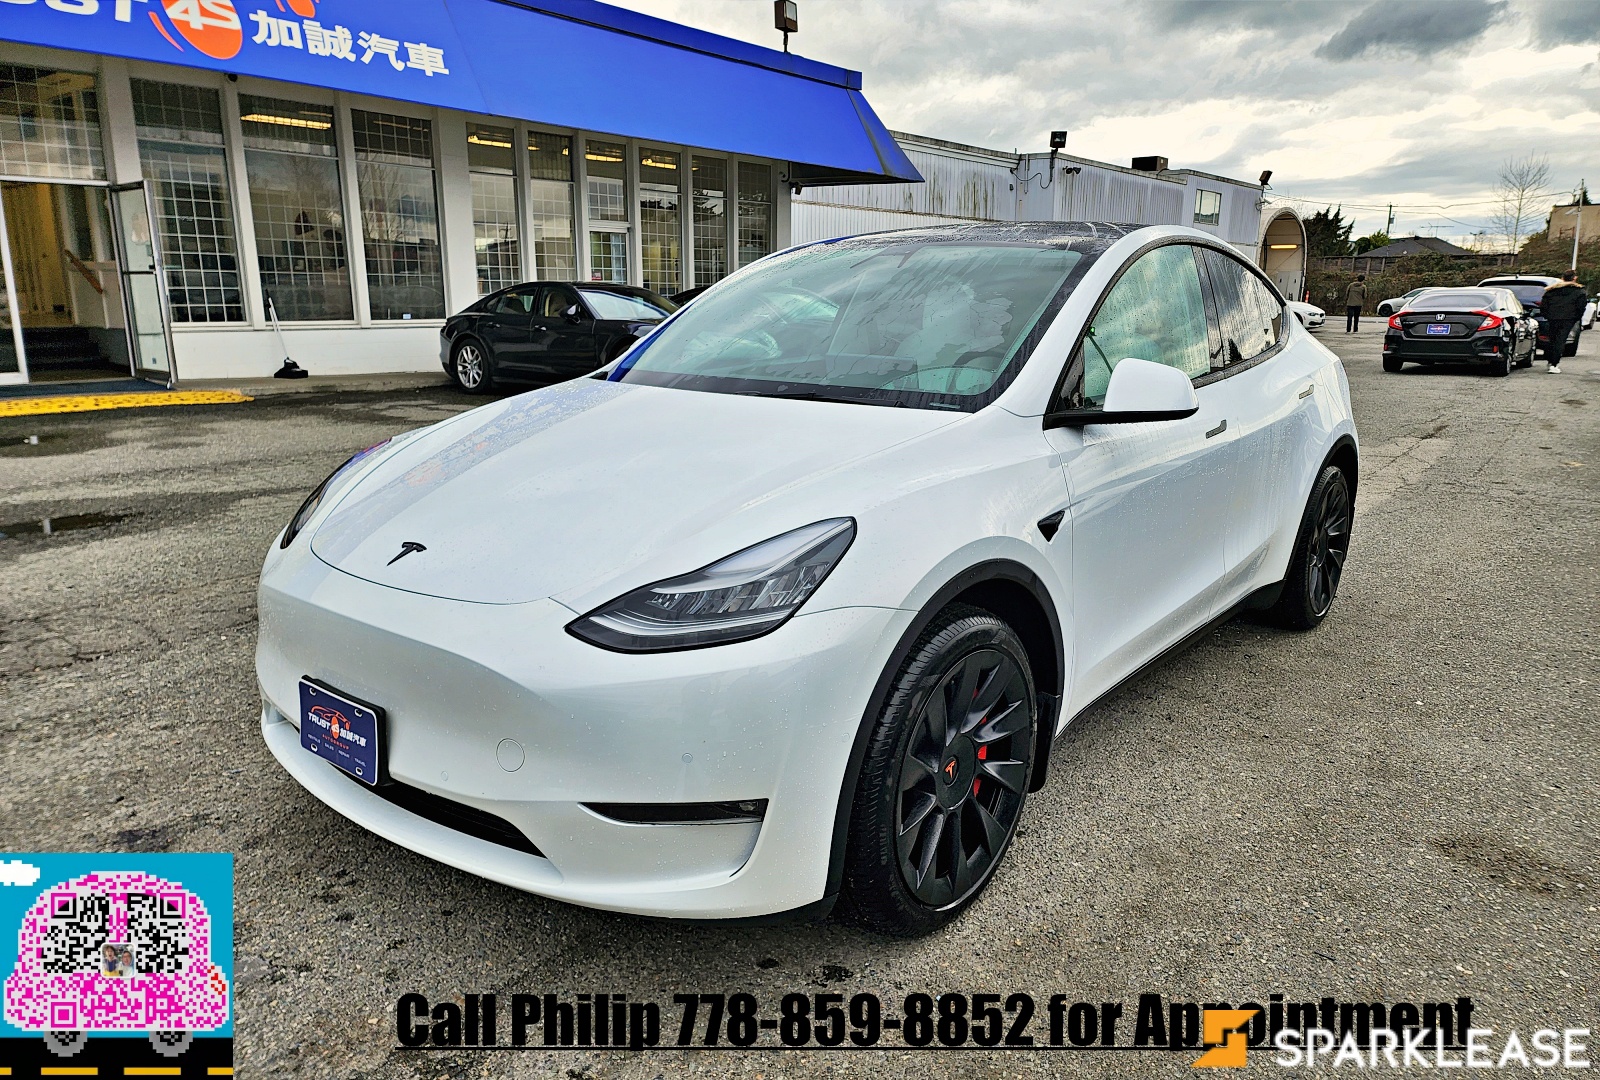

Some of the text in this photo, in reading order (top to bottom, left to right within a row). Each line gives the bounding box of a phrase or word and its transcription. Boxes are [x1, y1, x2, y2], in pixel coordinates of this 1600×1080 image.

[165, 0, 241, 30] 4S
[249, 9, 449, 77] 加誠汽車
[308, 712, 330, 730] TRUST
